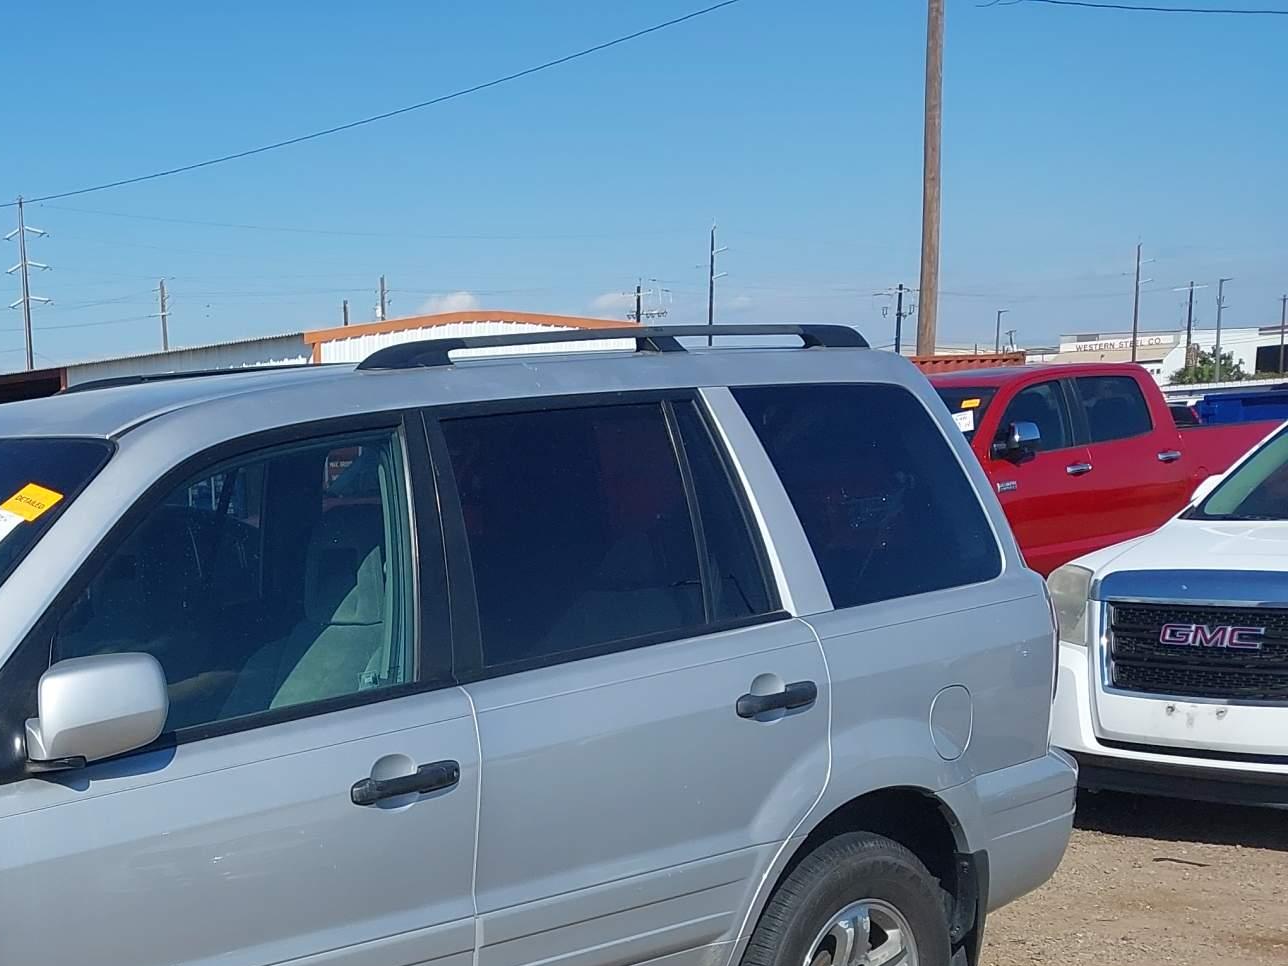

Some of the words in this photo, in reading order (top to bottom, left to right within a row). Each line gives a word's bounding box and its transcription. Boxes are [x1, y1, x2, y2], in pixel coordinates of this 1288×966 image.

[1075, 341, 1115, 353] WESTERN
[1119, 340, 1144, 349] STEEL
[14, 494, 45, 511] DETAILED
[1159, 623, 1264, 650] GMC
